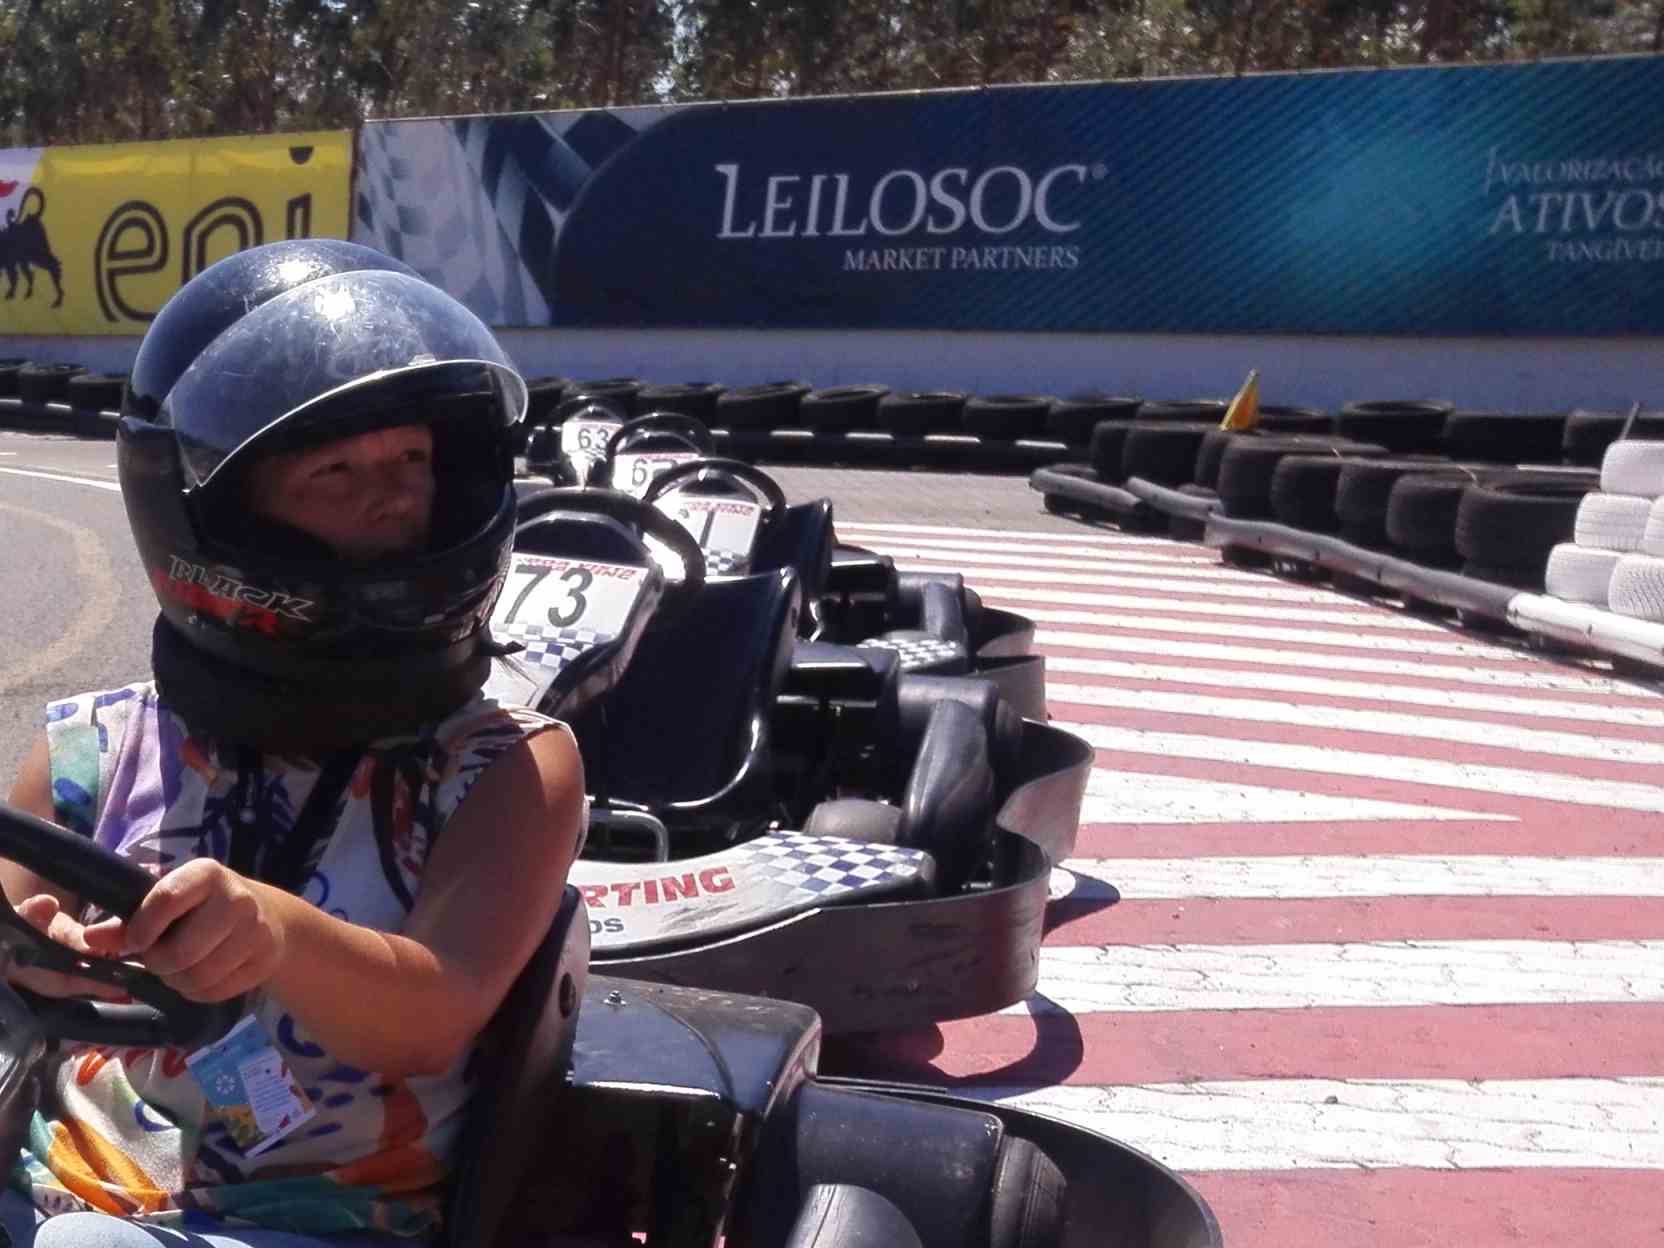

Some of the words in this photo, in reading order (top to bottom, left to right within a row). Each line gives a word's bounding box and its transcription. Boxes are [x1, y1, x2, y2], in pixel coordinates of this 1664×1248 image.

[842, 247, 944, 272] MARKET
[950, 244, 1080, 271] PARTNERS
[504, 563, 593, 628] 73
